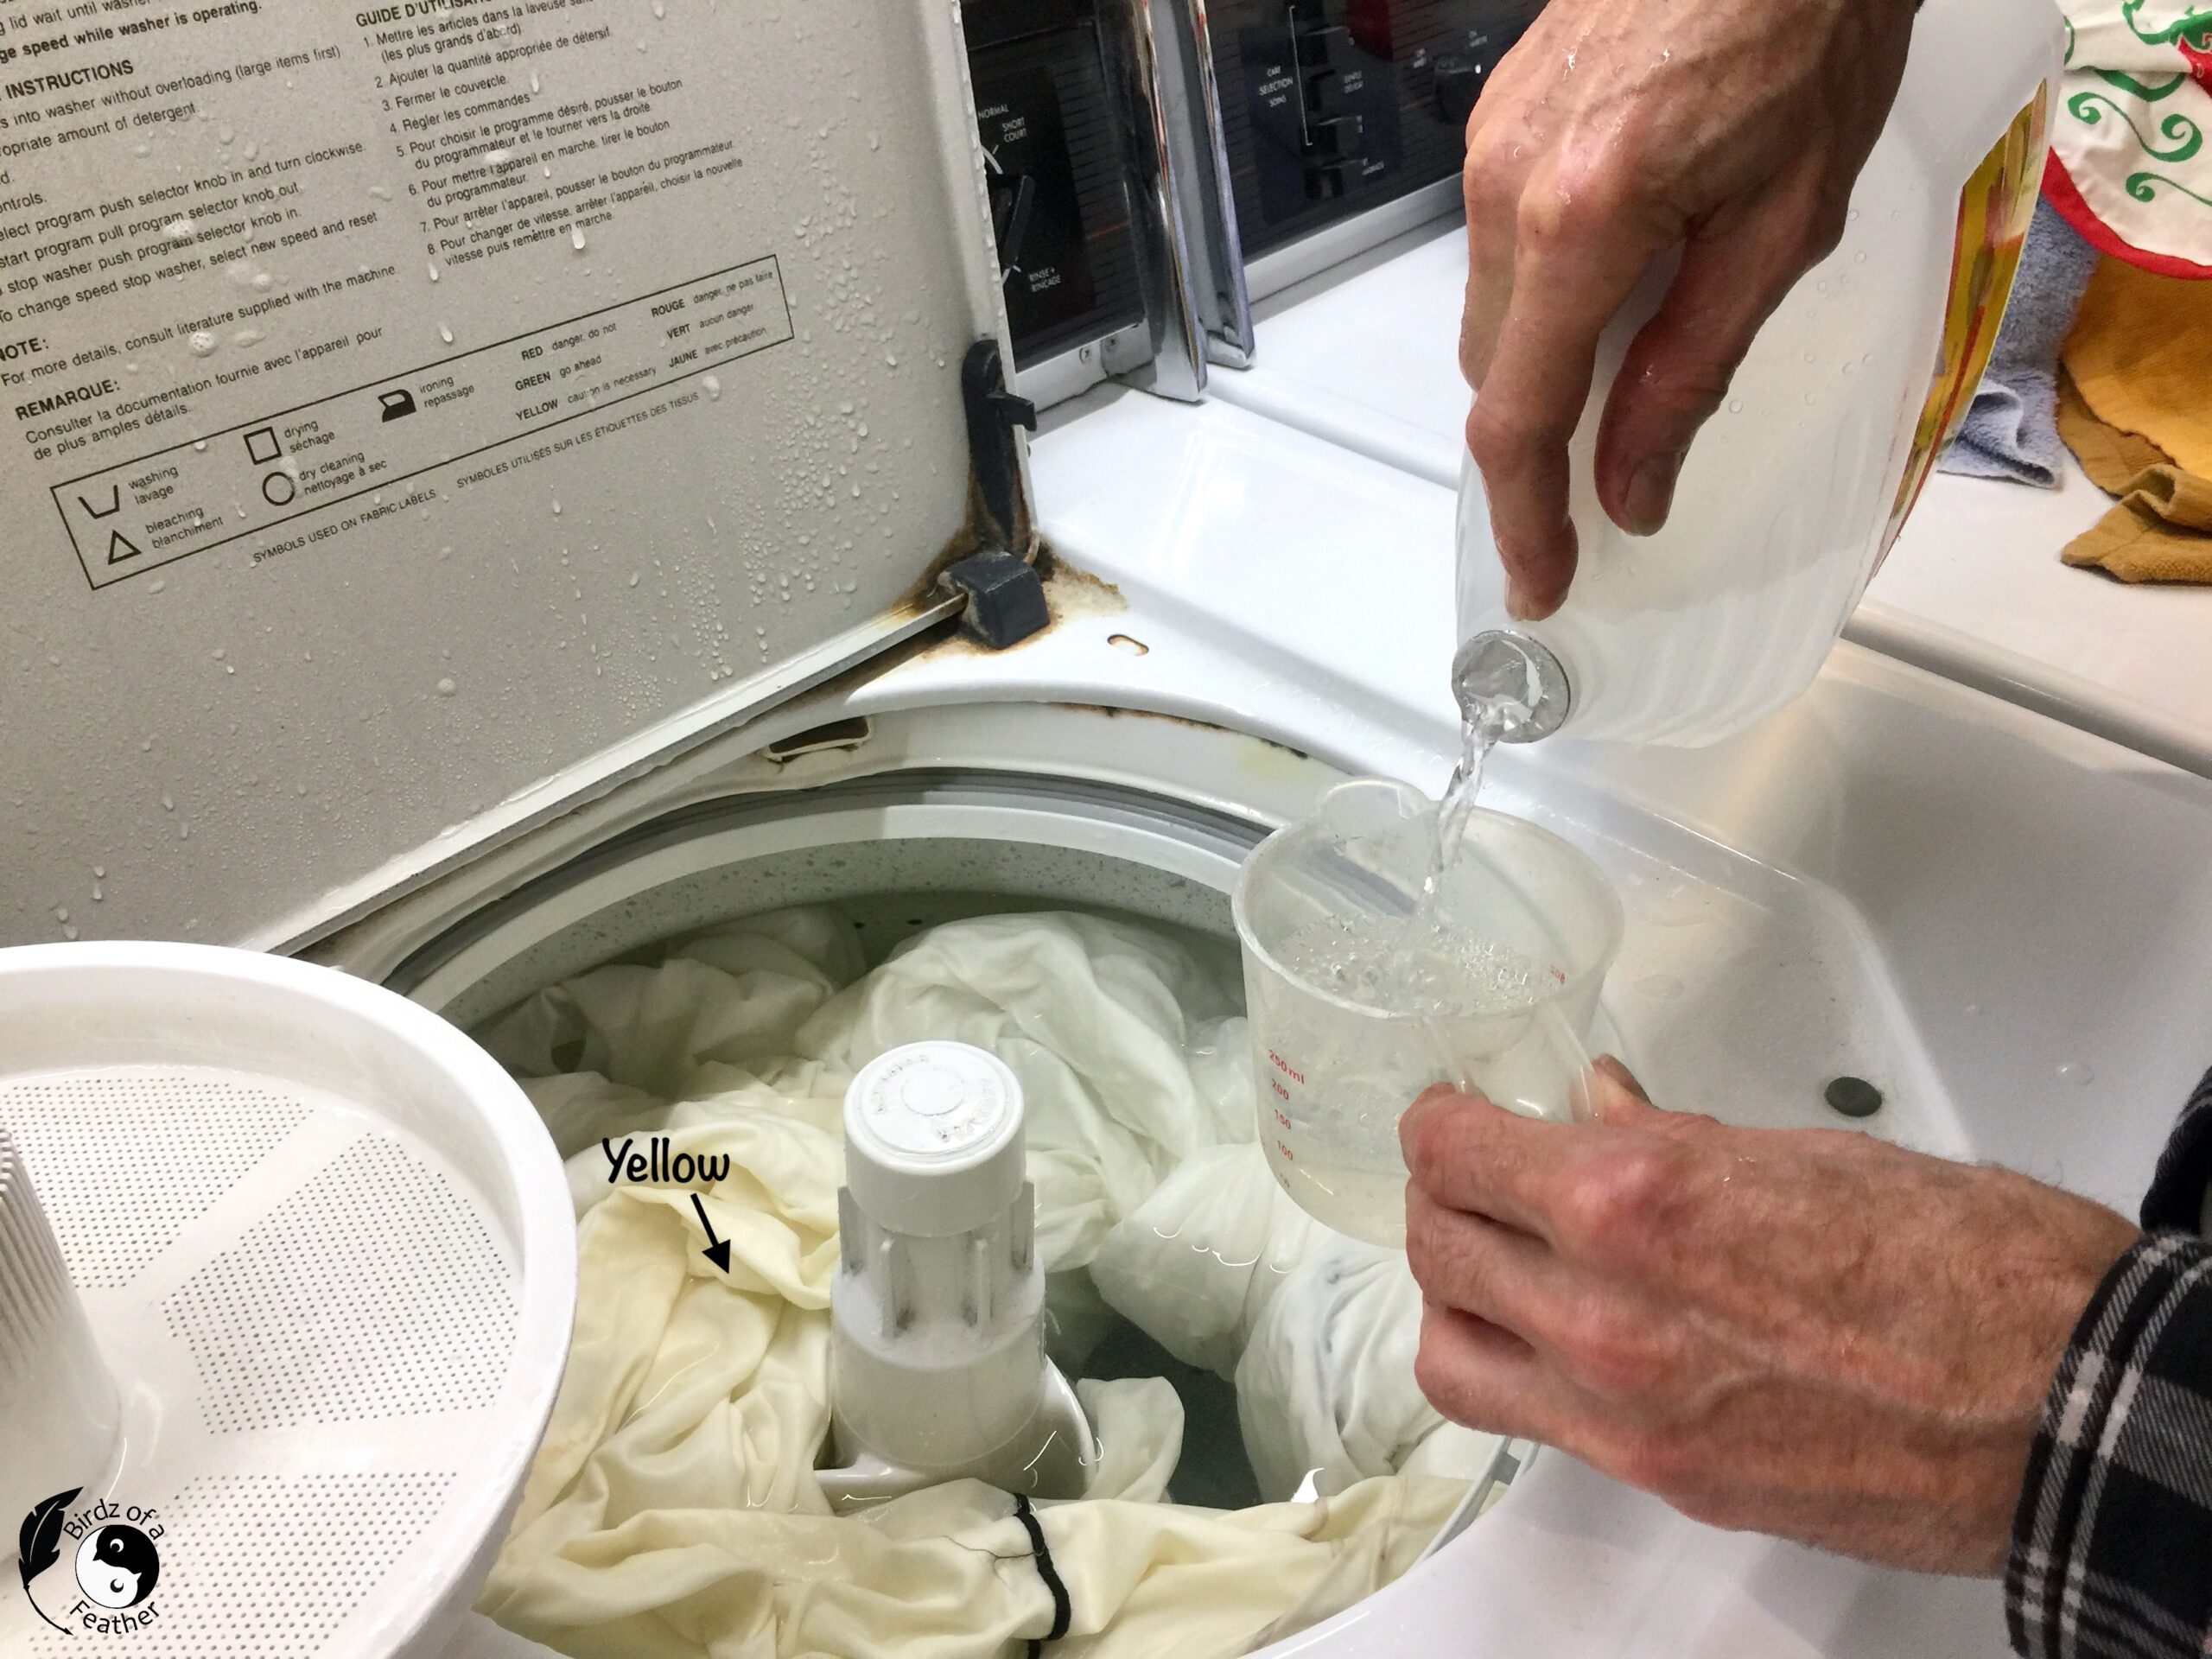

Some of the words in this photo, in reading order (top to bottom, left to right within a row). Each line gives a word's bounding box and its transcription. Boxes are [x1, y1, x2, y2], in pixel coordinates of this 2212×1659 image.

[9, 14, 28, 29] lid
[32, 9, 62, 25] wait
[67, 1, 98, 19] until
[22, 35, 69, 57] speed
[73, 27, 114, 45] while
[118, 15, 169, 35] washer
[174, 12, 188, 25] is
[193, 0, 262, 23] operating.
[356, 5, 402, 27] GUIDE
[376, 29, 414, 45] Mettre
[416, 25, 435, 36] les
[438, 16, 479, 33] articles
[482, 10, 509, 23] dans
[525, 0, 566, 14] laveuse
[381, 49, 403, 65] (les
[406, 43, 431, 60] plus
[435, 33, 474, 54] grands
[390, 68, 428, 86] Ajouter
[448, 52, 492, 73] quantité
[496, 40, 552, 63] appropriée
[5, 59, 134, 99] INSTRUCTIONS
[13, 111, 41, 125] into
[45, 99, 95, 118] washer
[101, 85, 152, 106] without
[156, 70, 232, 94] overloading
[235, 61, 272, 79] (large
[276, 54, 310, 68] items
[395, 91, 435, 108] Fermer
[410, 140, 435, 153] Pour
[441, 129, 475, 146] choisir
[493, 111, 554, 136] programme
[594, 92, 633, 111] pousser
[649, 79, 683, 95] bouton
[57, 122, 111, 143] amount
[115, 116, 128, 130] of
[415, 158, 429, 169] du
[434, 137, 515, 168] programmateur
[546, 120, 582, 137] tourner
[1004, 128, 1027, 143] COURT
[422, 178, 447, 192] Pour
[452, 165, 493, 184] mettre
[601, 133, 620, 145] tirer
[35, 207, 95, 234] program
[99, 197, 134, 218] push
[138, 184, 188, 206] selector
[194, 175, 226, 192] knob
[230, 171, 243, 182] in
[248, 162, 272, 178] and
[275, 158, 302, 172] turn
[433, 215, 459, 230] Pour
[463, 205, 498, 221] arrêter
[556, 178, 594, 199] pousser
[611, 165, 645, 181] bouton
[648, 160, 661, 170] du
[440, 237, 465, 251] Pour
[470, 224, 512, 243] changer
[575, 197, 607, 213] arrêter
[660, 174, 690, 188] choisir
[0, 251, 30, 270] start
[35, 235, 94, 262] program
[99, 225, 124, 245] pull
[128, 213, 184, 237] program
[188, 198, 238, 219] selector
[242, 188, 280, 205] knob
[445, 249, 483, 266] vitesse
[486, 241, 510, 257] puis
[512, 228, 556, 247] remettre
[8, 276, 38, 293] stop
[42, 262, 92, 283] washer
[98, 250, 133, 271] push
[137, 237, 193, 261] program
[196, 222, 245, 244] selector
[250, 212, 282, 228] knob
[285, 208, 302, 219] in.
[18, 295, 71, 317] change
[76, 280, 118, 302] speed
[123, 274, 151, 289] stop
[155, 259, 205, 280] washer,
[210, 246, 247, 265] select
[251, 240, 276, 254] new
[281, 226, 318, 247] speed
[322, 219, 345, 235] and
[349, 212, 378, 228] reset
[0, 371, 25, 386] For
[31, 360, 67, 378] more
[125, 327, 174, 351] consult
[177, 312, 234, 335] literature
[238, 293, 291, 318] supplied
[294, 286, 320, 302] with
[322, 281, 342, 293] the
[346, 266, 395, 287] machine
[651, 299, 685, 318] ROUGE
[521, 346, 543, 360] RED
[602, 323, 617, 334] not
[666, 323, 690, 340] VERT
[515, 372, 551, 391] GREEN
[575, 354, 601, 372] ahead
[669, 349, 698, 368] JAUNE
[15, 379, 120, 421] REMARQUE:
[25, 415, 92, 443] Consulter
[97, 410, 111, 422] la
[116, 380, 212, 416] documentation
[215, 365, 259, 385] fournie
[264, 355, 292, 371] avec
[295, 335, 349, 361] l'appareil
[356, 327, 382, 346] pour
[420, 377, 454, 393] ironing
[424, 385, 474, 408] repassage
[516, 398, 557, 421] YELLOW
[34, 448, 52, 461] de
[57, 436, 86, 455] plus
[92, 419, 140, 442] amples
[144, 404, 191, 425] détails.
[284, 421, 319, 438] drying
[457, 462, 509, 488] SYMBOLES
[554, 439, 573, 452] SUR
[575, 432, 593, 444] LES
[650, 404, 667, 416] DES
[669, 392, 699, 409] TISSUS
[129, 467, 179, 489] washing
[135, 486, 174, 505] lavage
[145, 508, 204, 534] bleaching
[152, 517, 223, 549] blanchiment
[253, 537, 305, 563] SYMBOLS
[308, 525, 338, 543] USED
[341, 518, 357, 531] ON
[360, 503, 397, 524] FABRIC
[398, 489, 436, 510] LABELS
[1268, 1049, 1287, 1072] 250
[1272, 1078, 1289, 1101] 200
[1274, 1109, 1291, 1130] 150
[1277, 1140, 1294, 1161] 100
